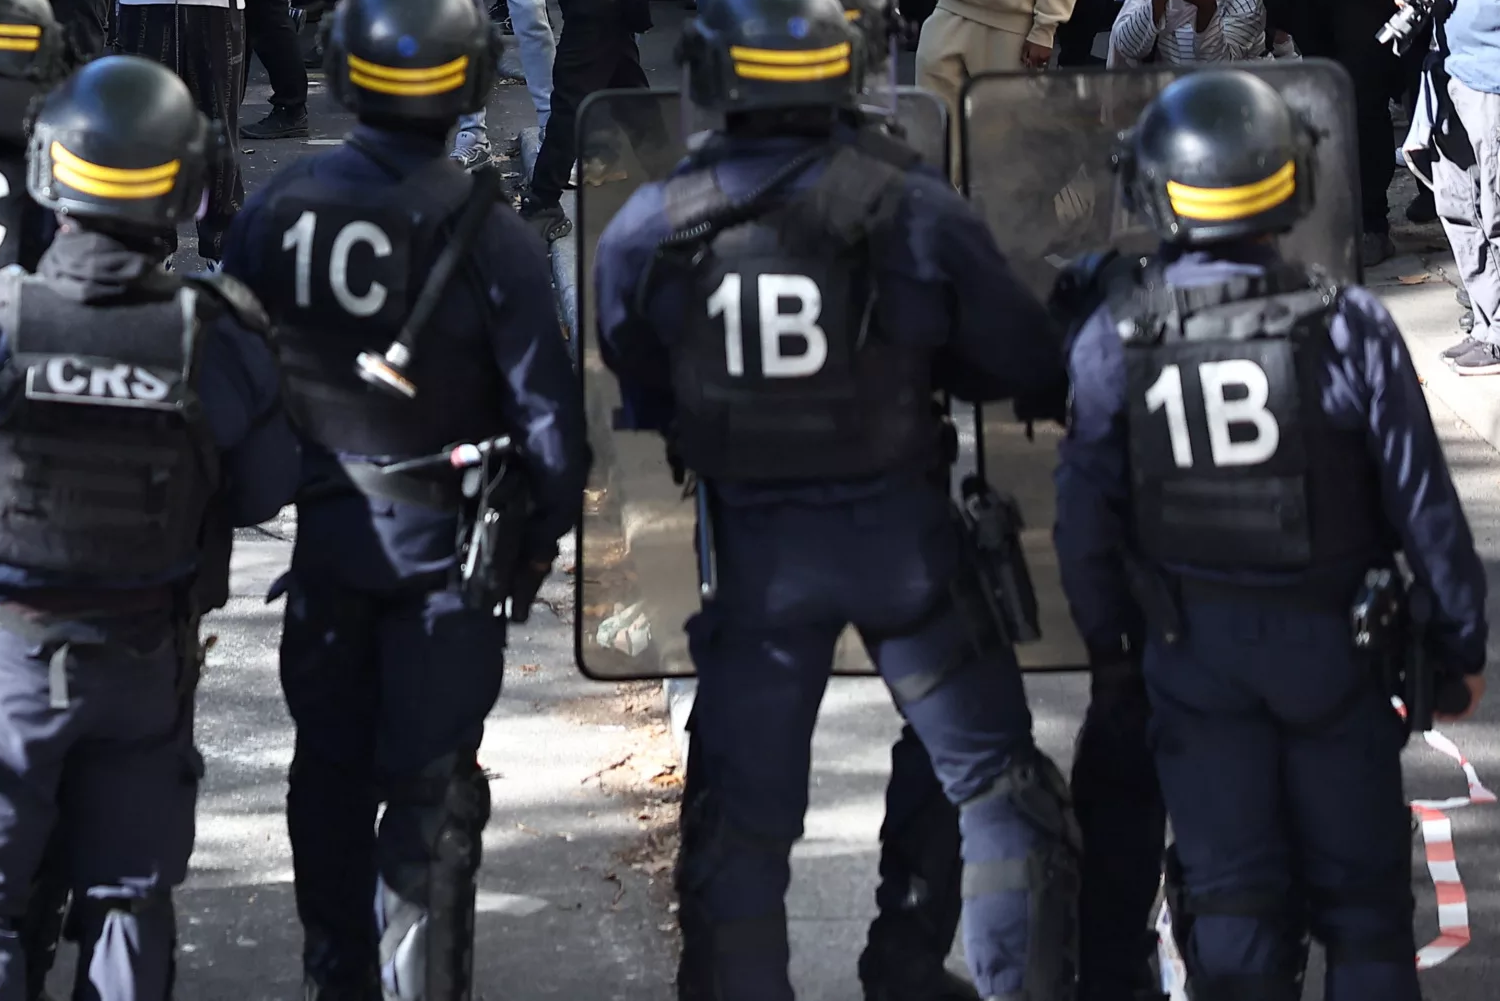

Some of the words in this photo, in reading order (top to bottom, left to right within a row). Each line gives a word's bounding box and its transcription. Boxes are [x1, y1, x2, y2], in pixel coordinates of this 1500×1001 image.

[282, 210, 393, 316] 1C
[708, 273, 827, 376] 1B
[1146, 359, 1279, 466] 1B
